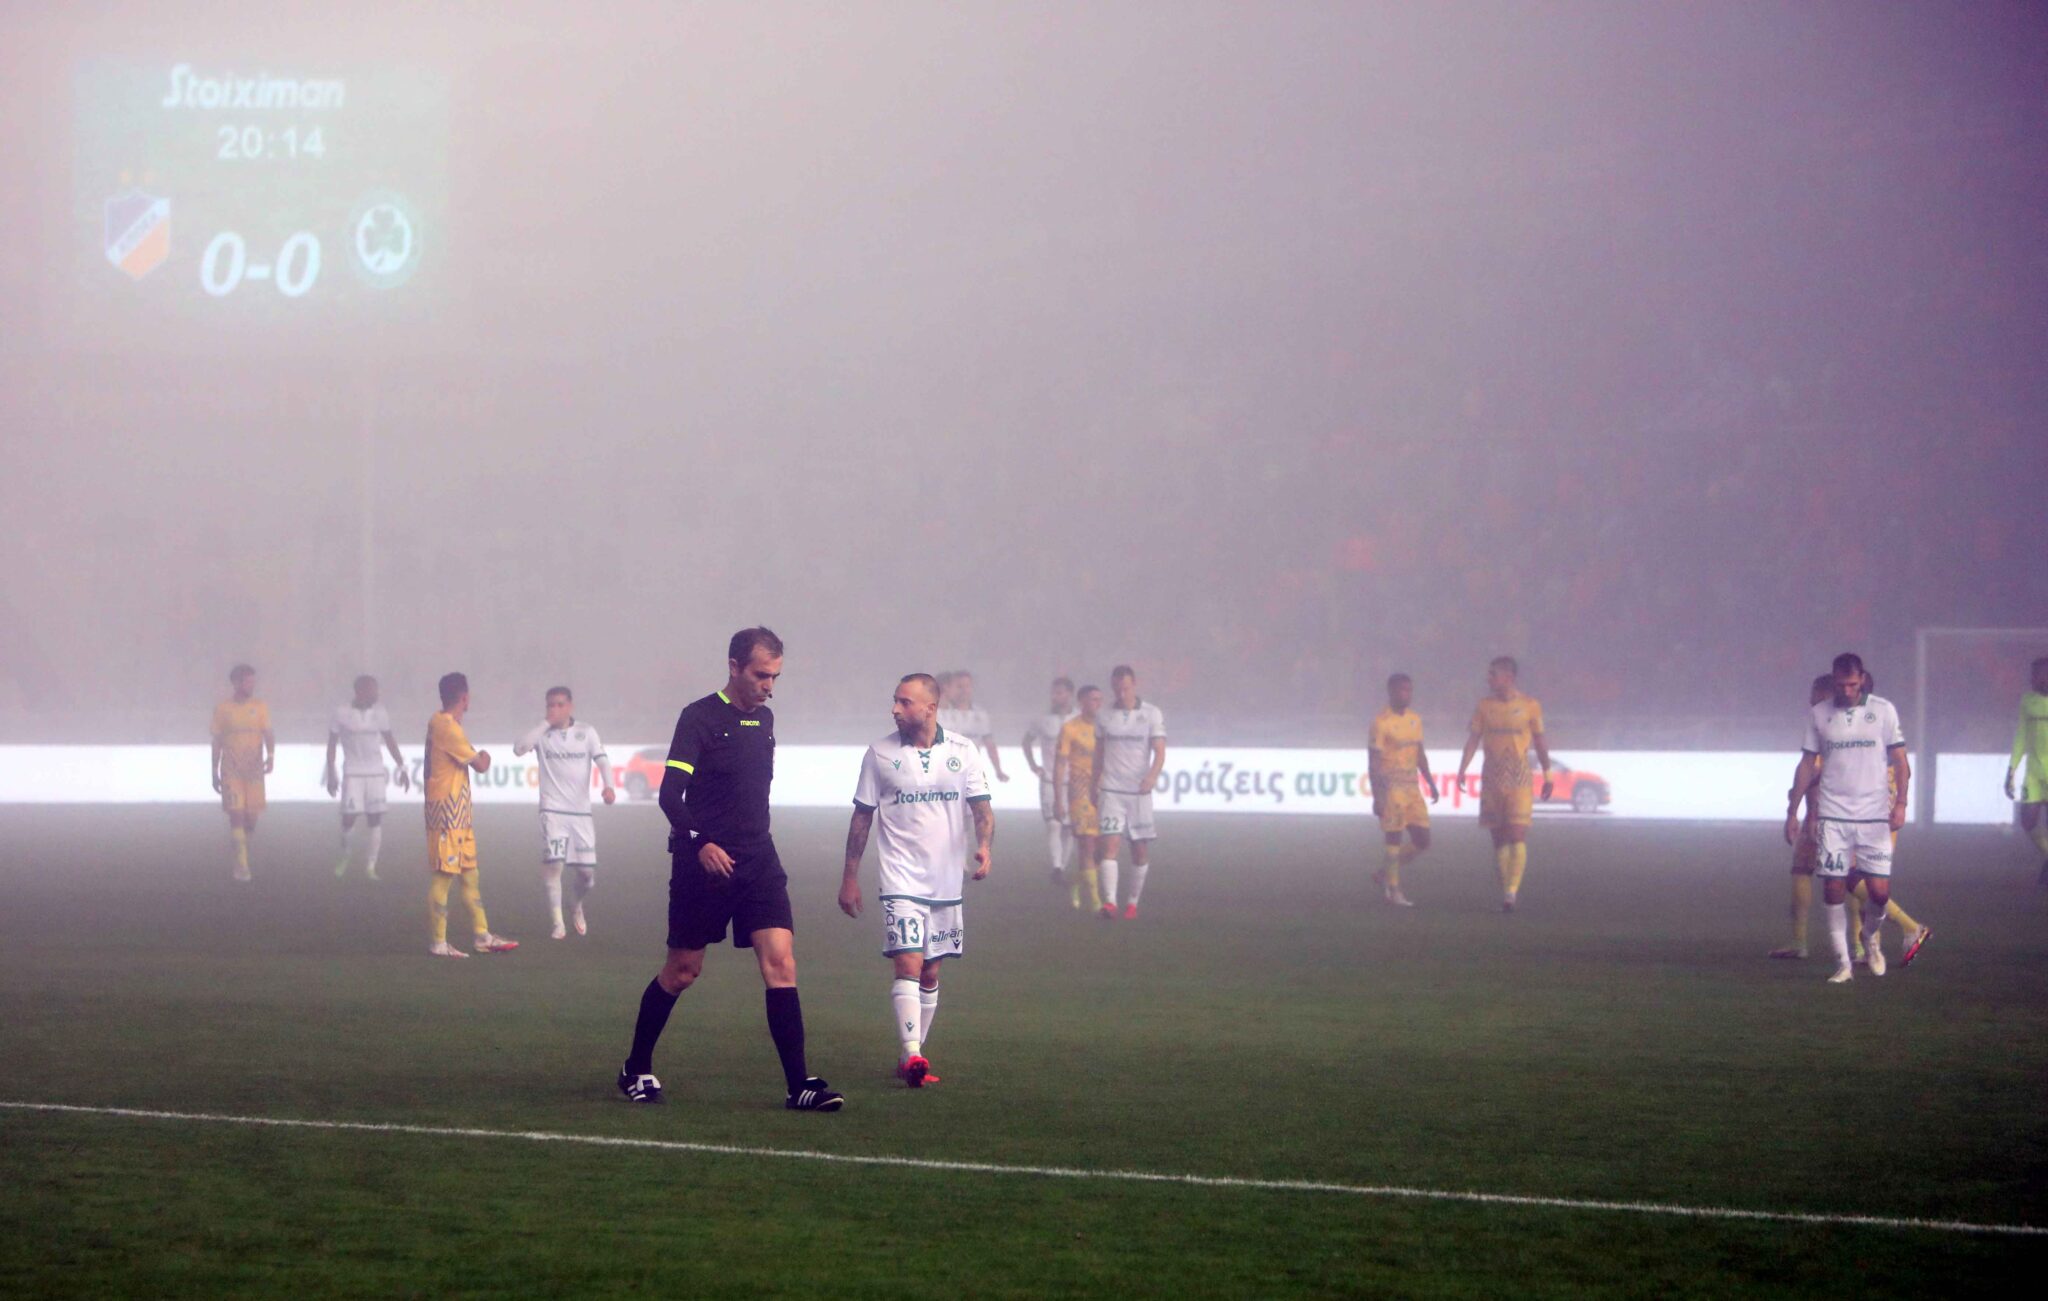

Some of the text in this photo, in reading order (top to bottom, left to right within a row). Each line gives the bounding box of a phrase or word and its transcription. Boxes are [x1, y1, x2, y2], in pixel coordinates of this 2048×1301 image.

[162, 63, 346, 109] Stoiximan
[217, 124, 325, 160] 20:14
[200, 231, 321, 298] 0-0
[894, 789, 960, 805] Stoiximan
[1154, 760, 1285, 803] οράζεις
[1103, 816, 1120, 832] 22
[1824, 852, 1844, 872] 44
[897, 917, 921, 945] 13
